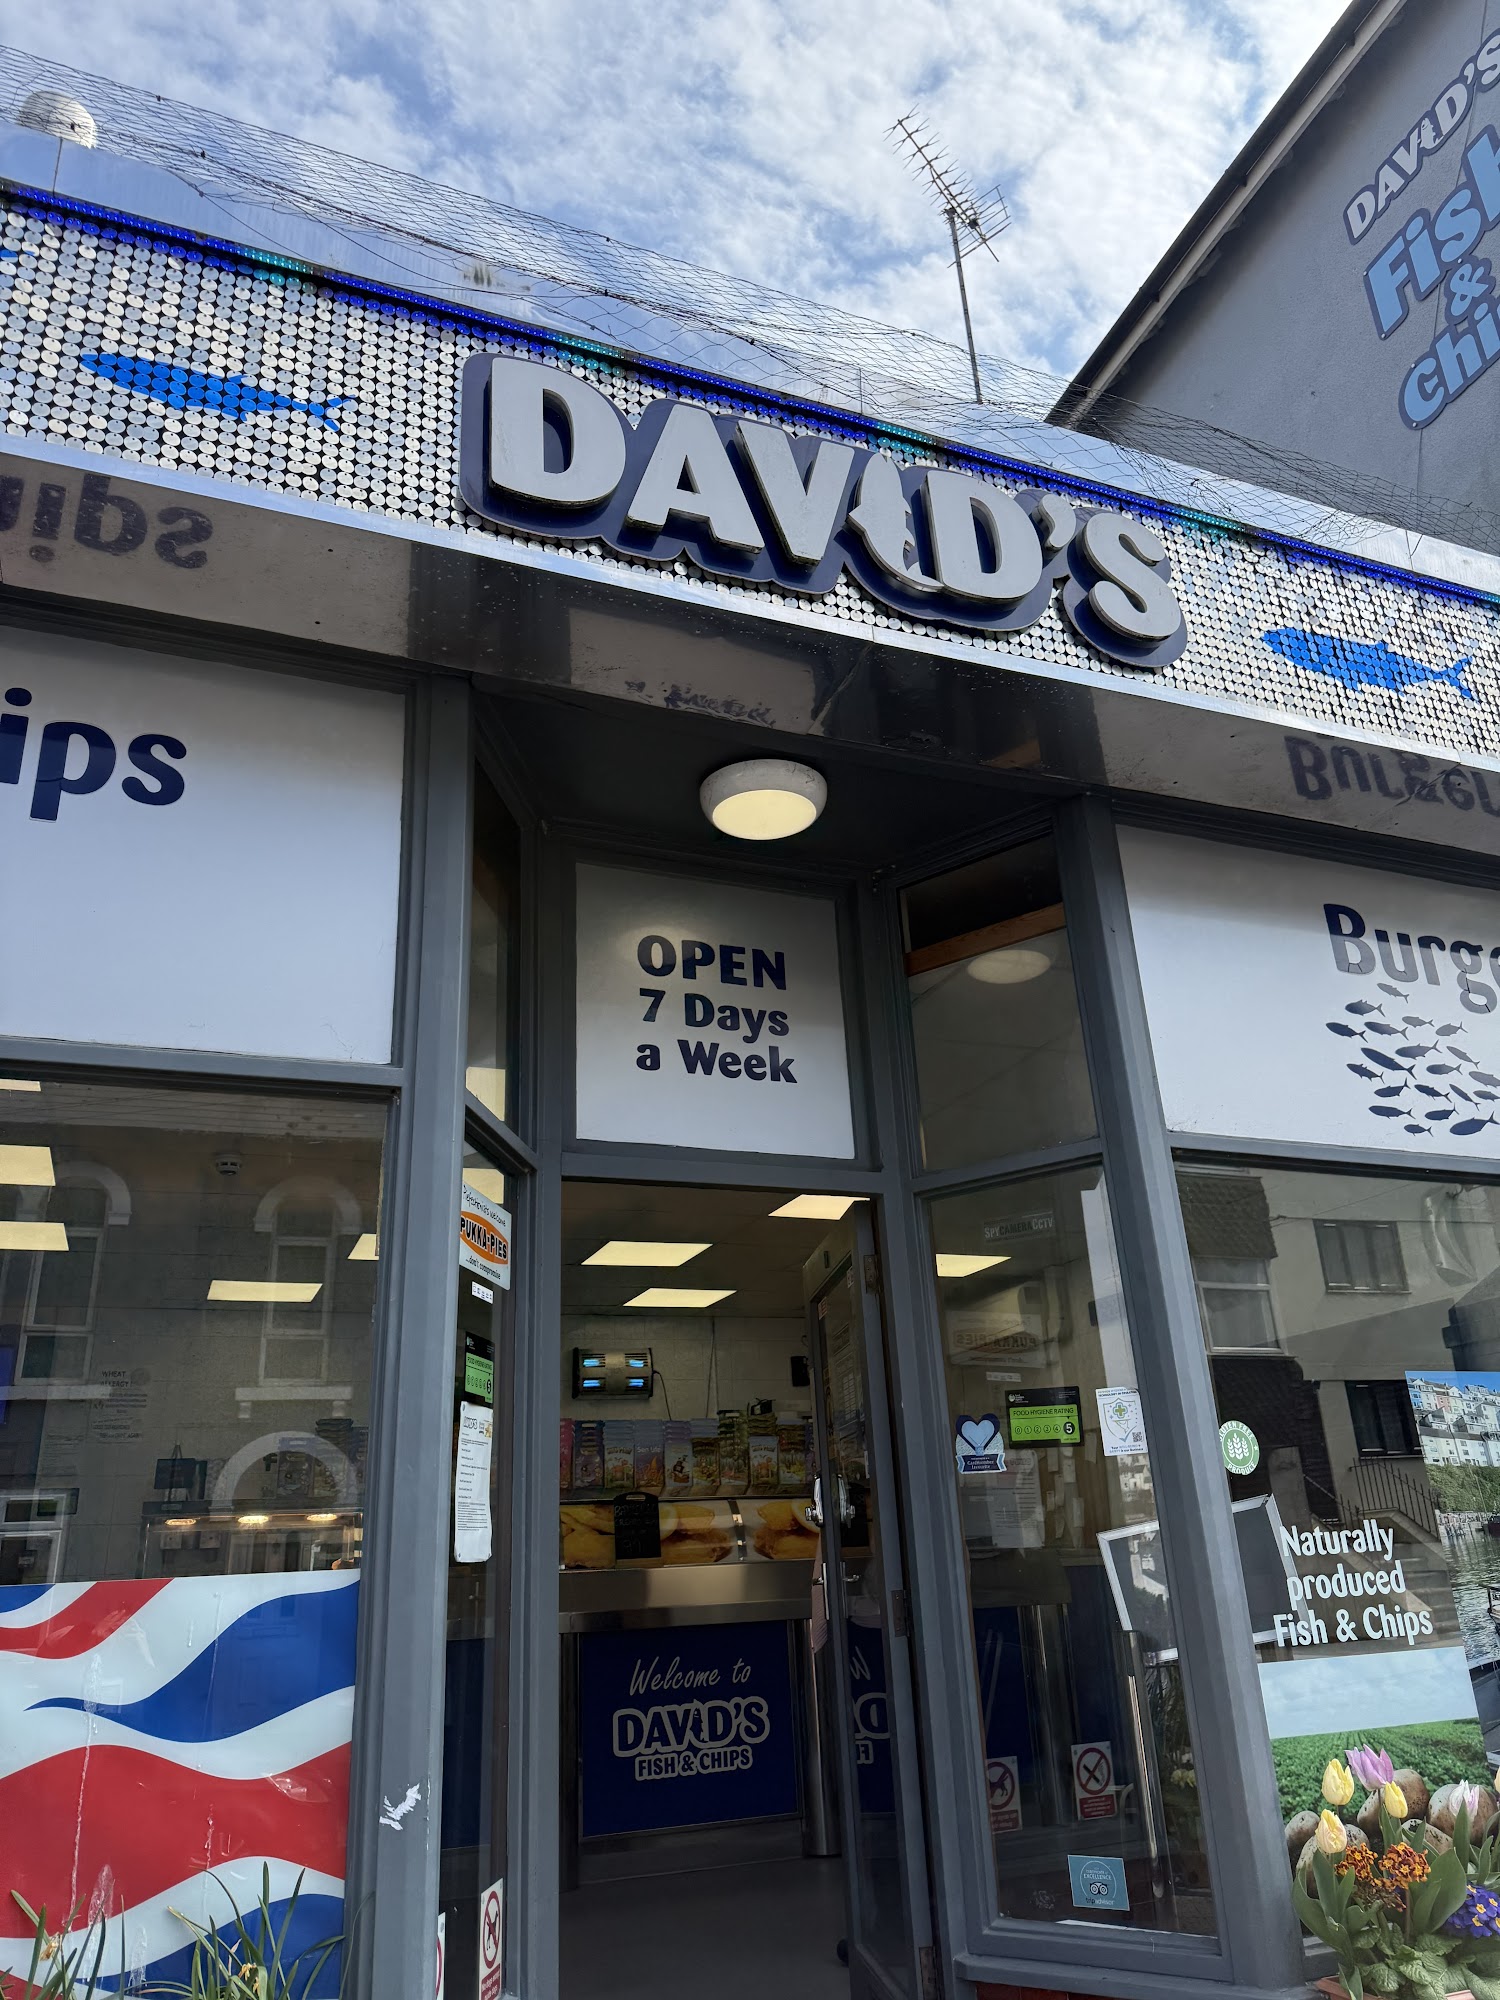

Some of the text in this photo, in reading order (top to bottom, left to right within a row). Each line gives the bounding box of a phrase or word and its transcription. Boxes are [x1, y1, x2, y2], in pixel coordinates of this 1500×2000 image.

[1450, 262, 1490, 317] &
[489, 356, 1182, 642] DAVID'S
[637, 934, 787, 990] OPEN
[639, 988, 790, 1044] 7 Days
[636, 1039, 798, 1084] a Week
[1066, 1423, 1073, 1434] 5
[1239, 1423, 1255, 1440] FREE
[1228, 1461, 1255, 1475] PRODUCE
[1279, 1519, 1394, 1561] Naturally
[1286, 1560, 1407, 1611] produced
[1273, 1603, 1434, 1647] Fish & Chips
[629, 1656, 752, 1696] Welcome to
[614, 1697, 770, 1756] DAVID'S
[637, 1750, 750, 1778] FISH & CHIPS
[1085, 1897, 1115, 1906] tripadvisor
